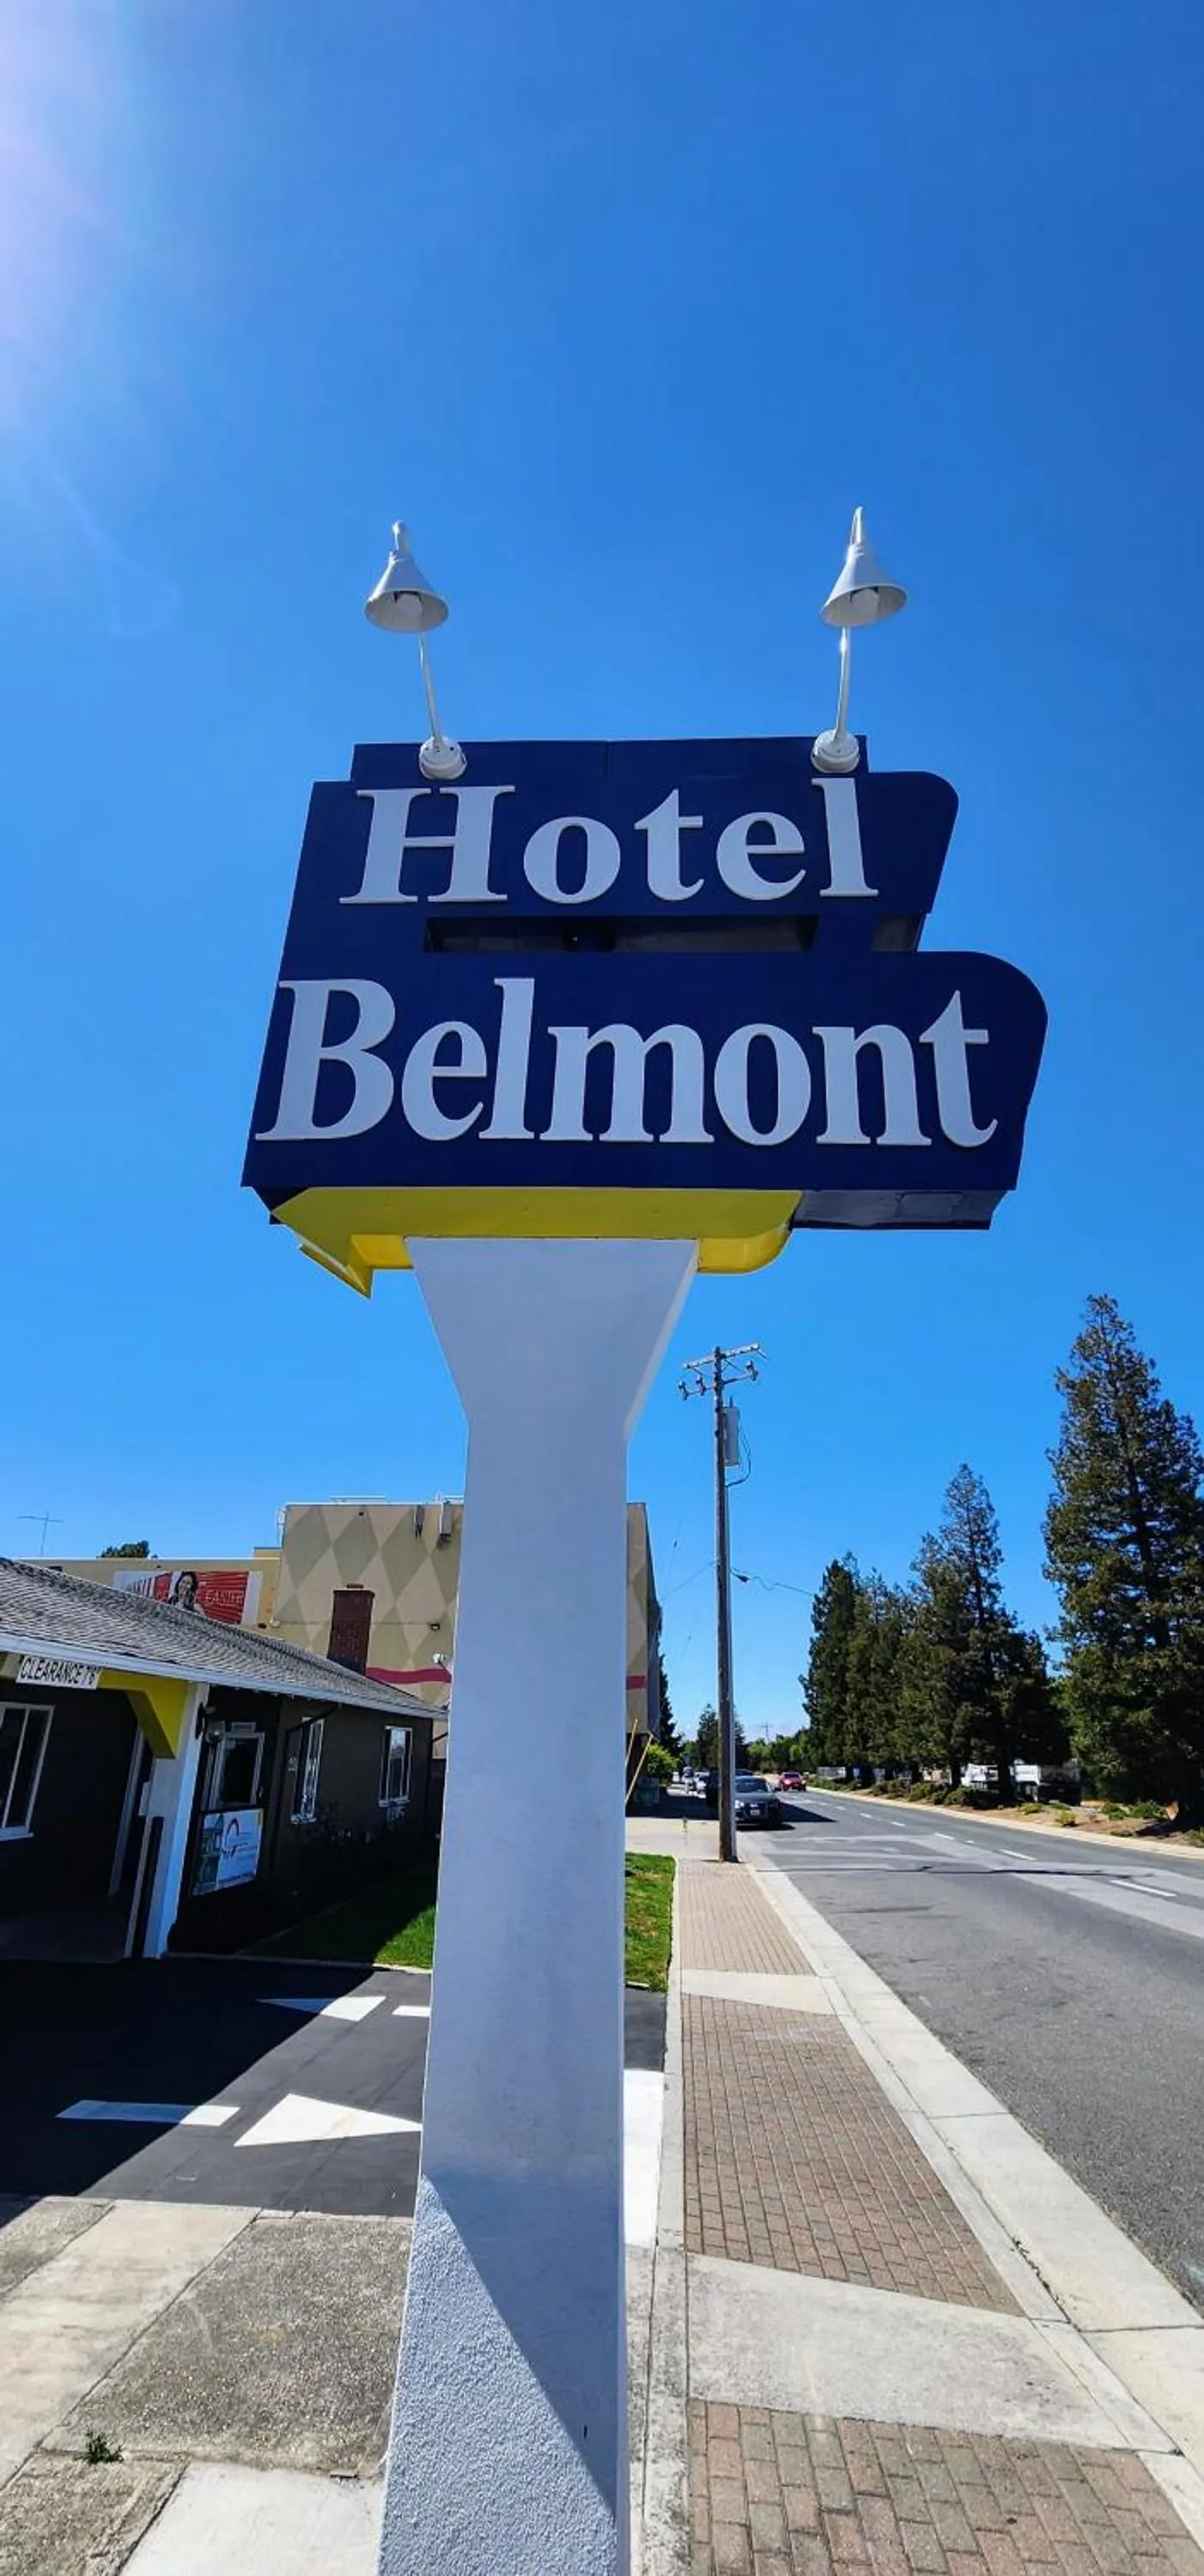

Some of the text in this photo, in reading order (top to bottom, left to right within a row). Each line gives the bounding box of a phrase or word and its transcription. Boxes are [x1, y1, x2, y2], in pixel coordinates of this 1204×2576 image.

[339, 777, 879, 904] Hotel
[254, 978, 999, 1148] Belmont
[20, 1657, 84, 1684] CLEARANCE
